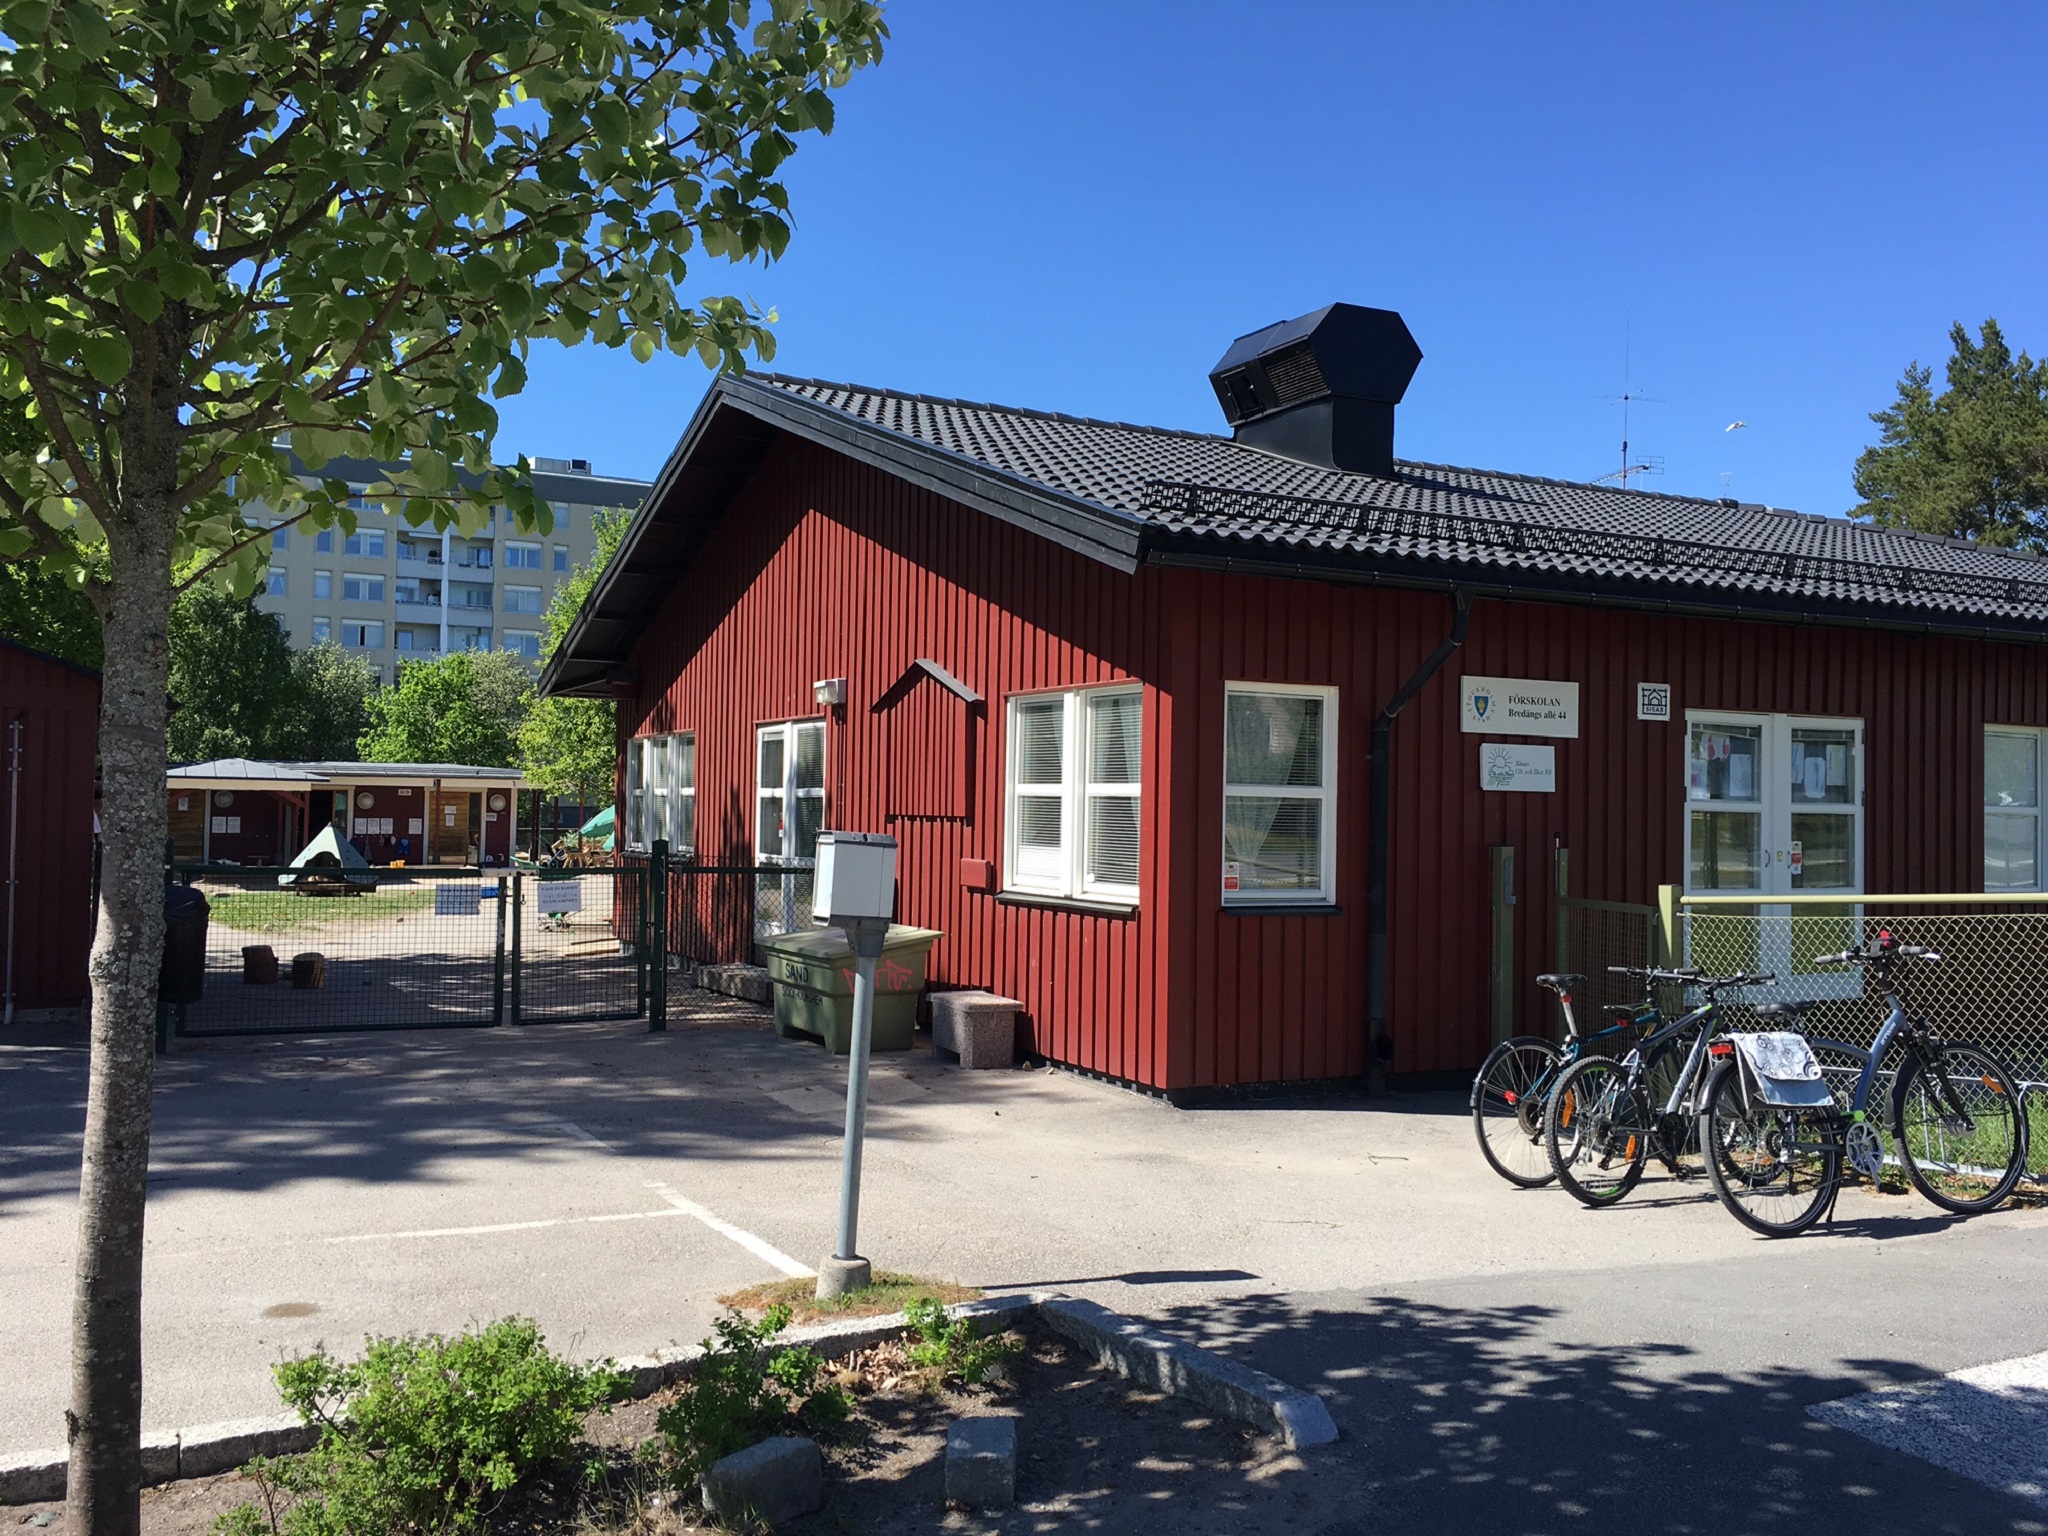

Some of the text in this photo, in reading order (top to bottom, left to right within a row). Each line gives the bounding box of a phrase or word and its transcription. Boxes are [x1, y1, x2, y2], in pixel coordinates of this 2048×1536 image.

[1467, 687, 1496, 713] STOCKHOLMS
[1508, 694, 1561, 706] FÖRSKOLAN
[1473, 715, 1491, 723] STAD
[1508, 708, 1567, 720] Bredängs allé 44
[784, 962, 809, 984] SAND
